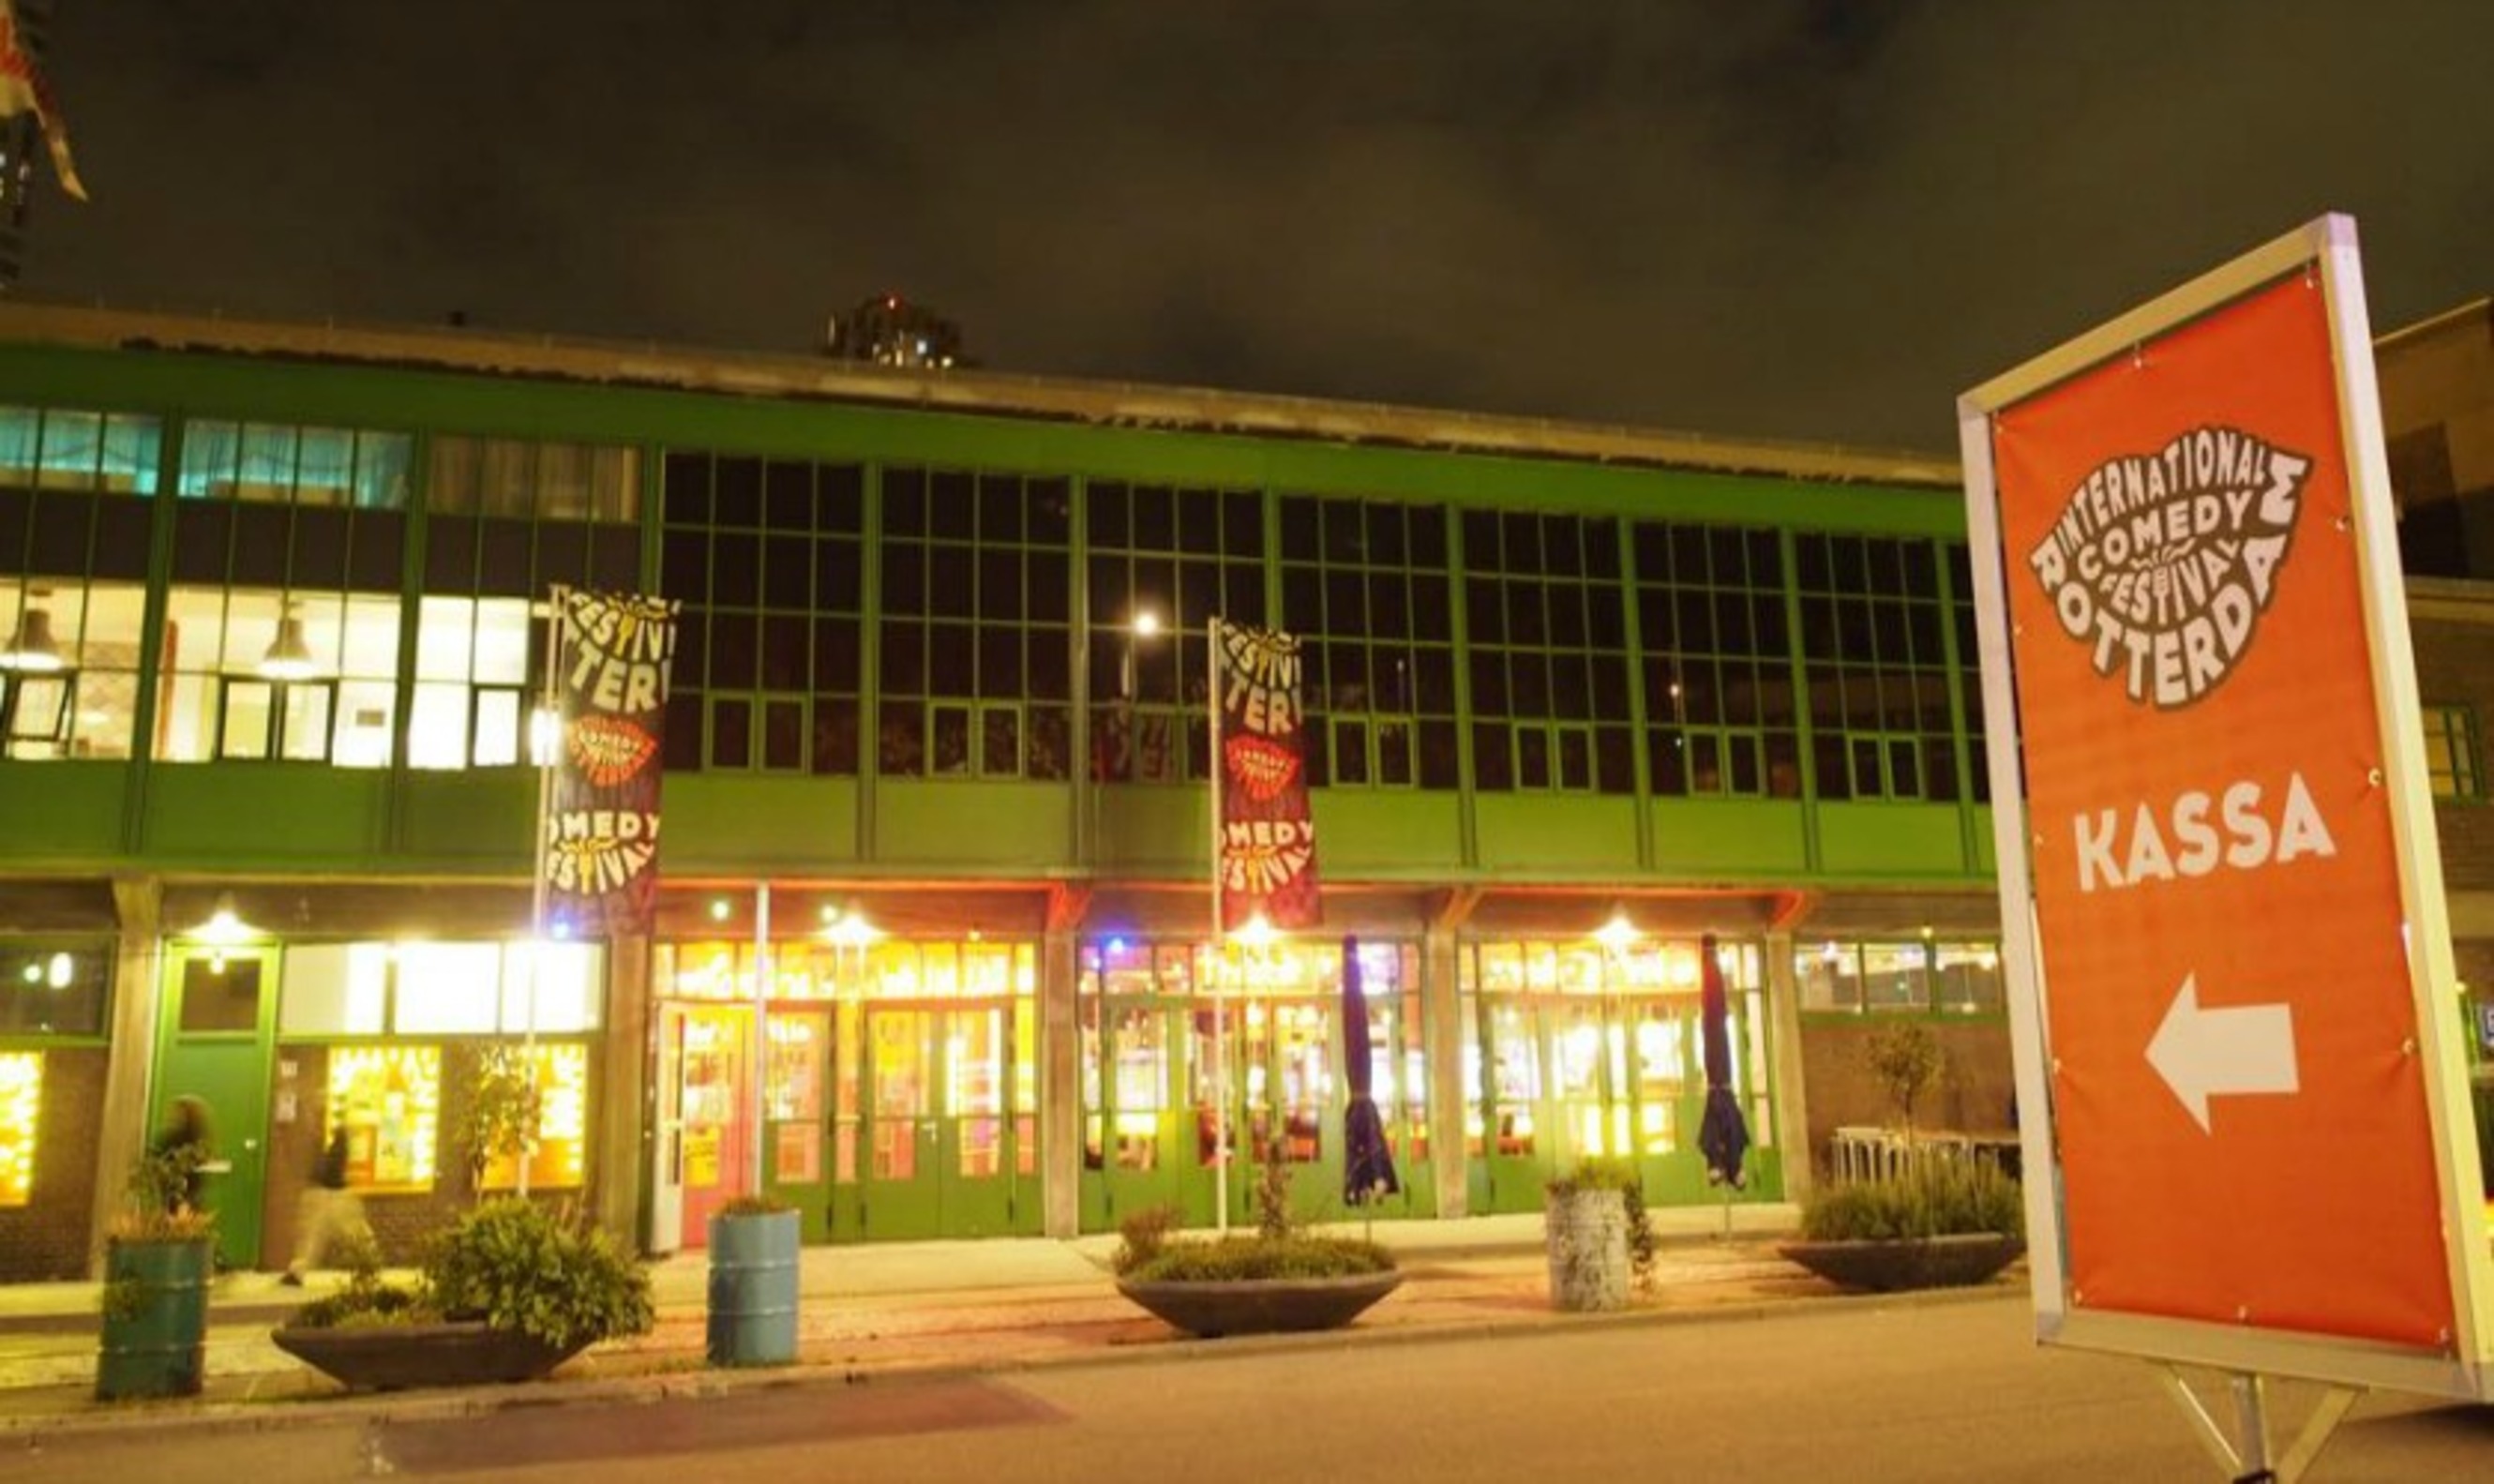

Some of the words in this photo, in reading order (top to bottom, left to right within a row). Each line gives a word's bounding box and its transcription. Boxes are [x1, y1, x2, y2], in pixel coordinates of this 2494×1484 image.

[2053, 428, 2267, 559] INTERNATIONAL
[2077, 490, 2254, 581] COMEDY
[2030, 450, 2308, 705] ROTTERDAM
[2098, 538, 2241, 626] FESTIVAL
[2074, 771, 2337, 893] KASSA
